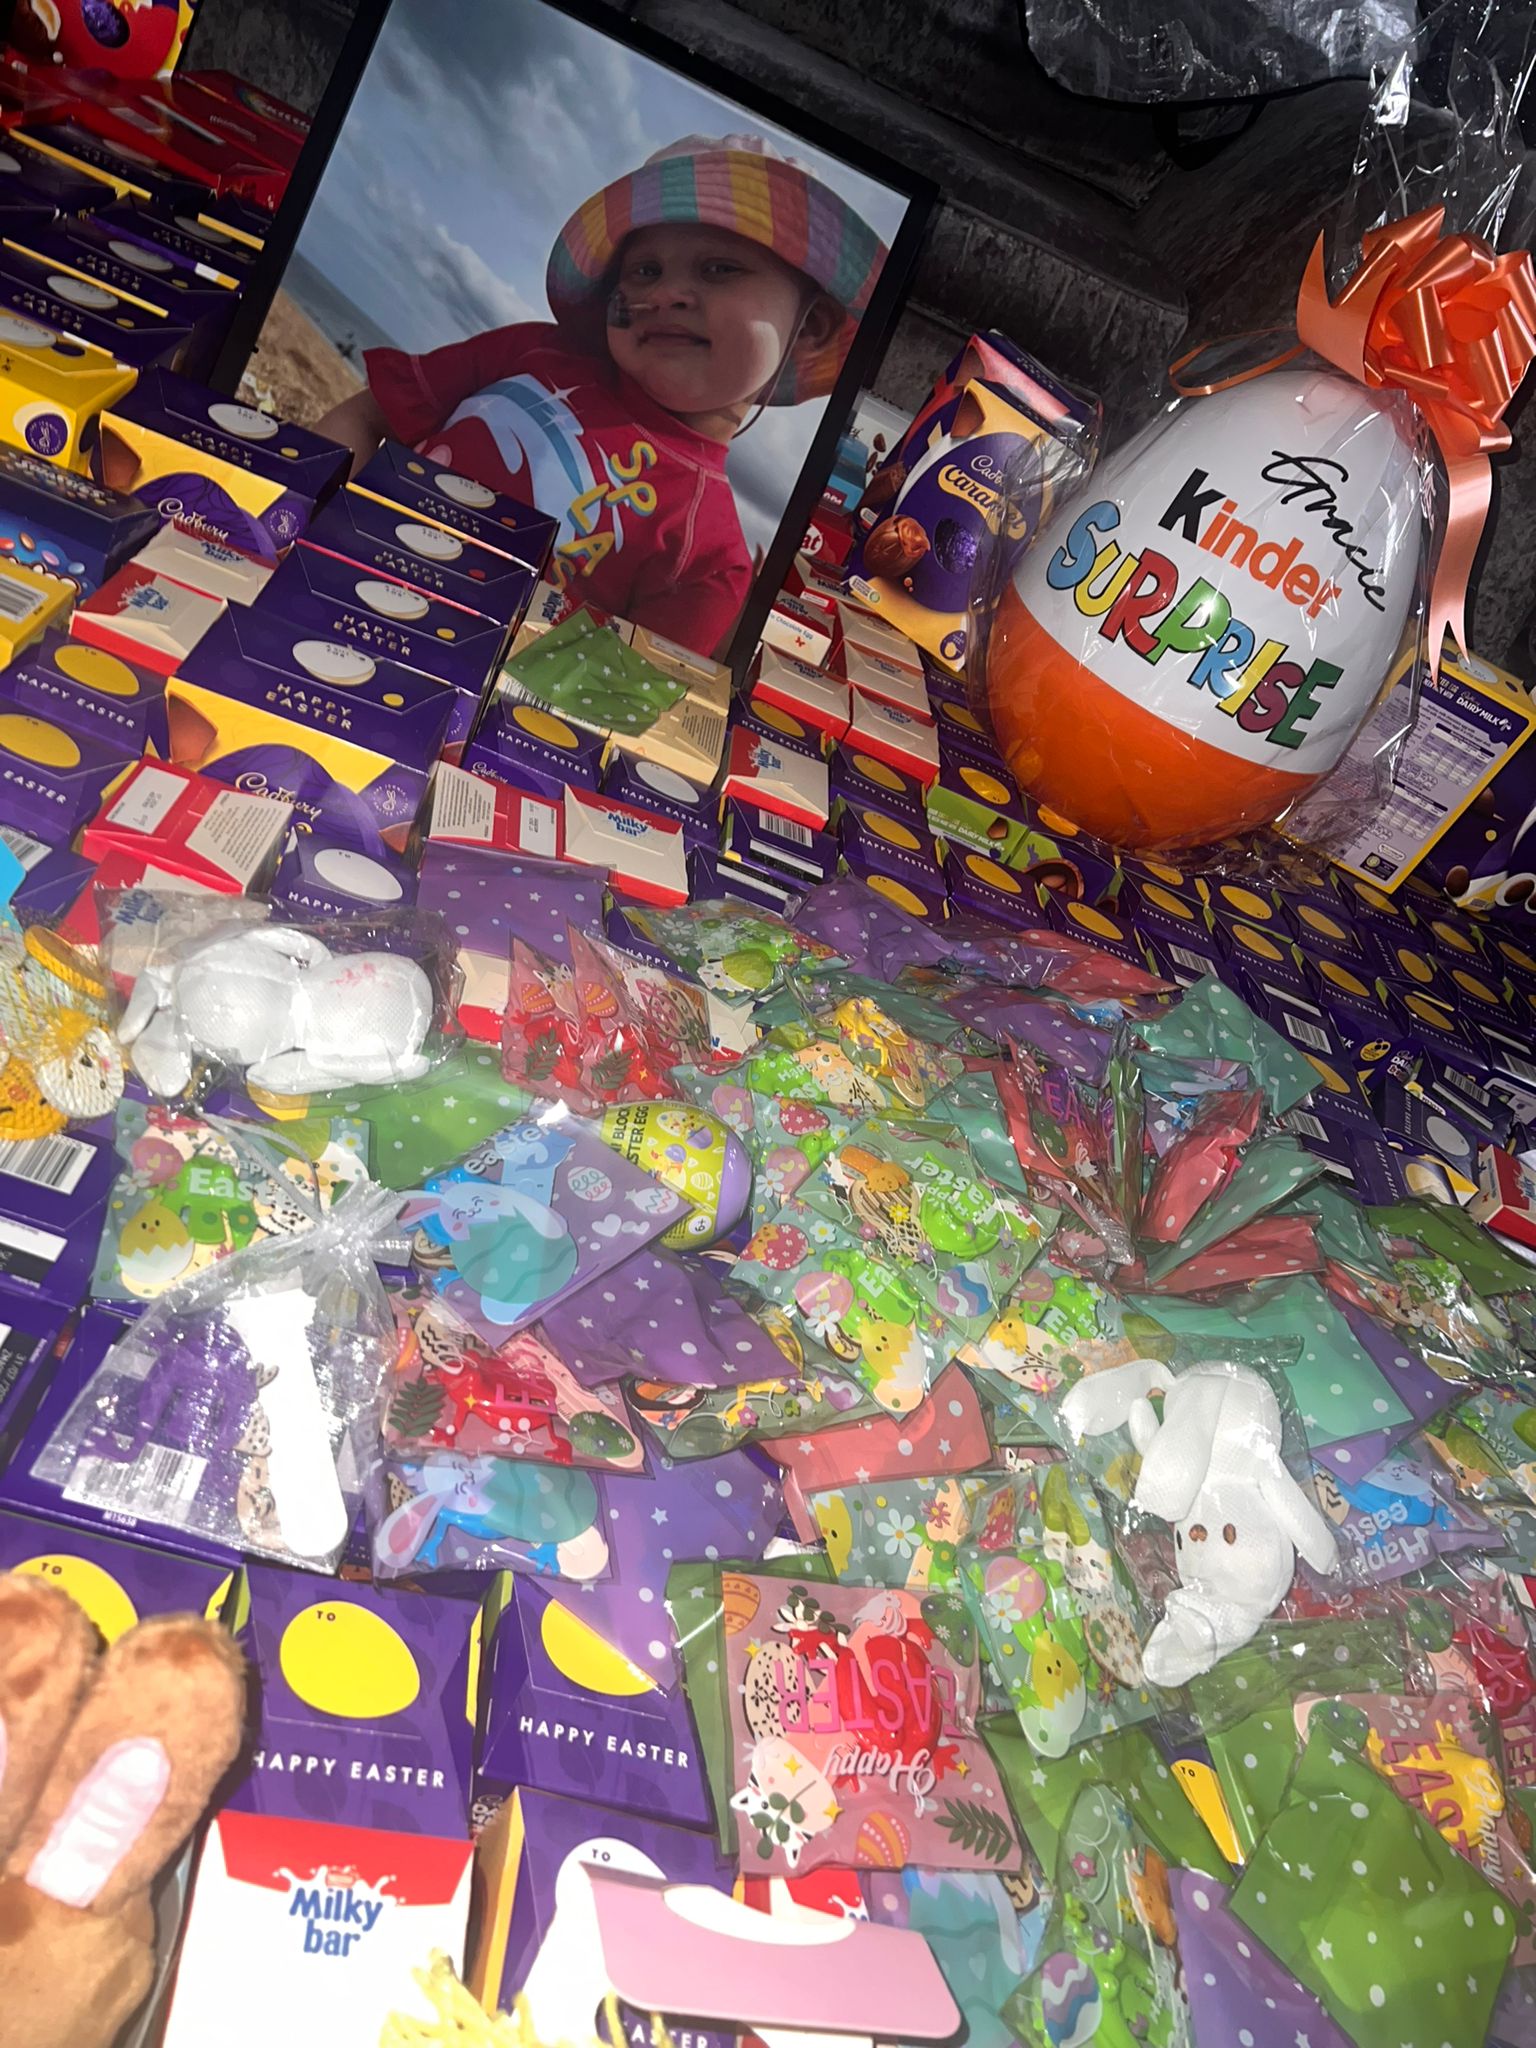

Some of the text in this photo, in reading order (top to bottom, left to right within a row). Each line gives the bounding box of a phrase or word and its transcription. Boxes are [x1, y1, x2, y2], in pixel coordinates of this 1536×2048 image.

[158, 497, 229, 541] Cadbury
[1261, 450, 1386, 612] Gracie
[1159, 468, 1342, 619] Kinder
[333, 621, 411, 656] EASTER
[343, 614, 409, 643] HAPPY
[1046, 500, 1345, 750] SURPRISE
[17, 672, 136, 729] HAPPY EASTER
[266, 691, 352, 730] EASTER
[277, 683, 352, 716] HAPPY
[1456, 697, 1501, 726] DAIRY MILK
[497, 731, 589, 776] HAPPY EASTER
[741, 719, 816, 759] HAPPY EASTER
[3, 770, 67, 805] EASTER
[236, 772, 323, 822] Cadbury
[844, 775, 917, 814] HAPPY EASTER
[608, 812, 649, 833] Milky
[621, 787, 709, 831] HAPPY EASTER
[616, 823, 641, 838] bar
[859, 837, 936, 874] HAPPY EASTER
[289, 891, 343, 914] HAPPY
[964, 882, 1038, 917] HAPPY EASTER
[1142, 908, 1209, 942] HAPPY EASTER
[626, 947, 670, 968] HAPPY
[1067, 929, 1140, 964] HAPPY EASTER
[1235, 951, 1300, 983] HAPPY EASTER
[614, 1105, 630, 1140] BLOCK
[634, 1104, 650, 1126] EGG
[1334, 1101, 1370, 1121] EASTER
[1343, 1501, 1409, 1545] east
[41, 1563, 62, 1575] TO
[316, 1610, 336, 1622] TO
[775, 1658, 965, 1739] EASTER
[519, 1716, 690, 1769] HAPPY EASTER
[252, 1750, 445, 1789] HAPPY EASTER
[820, 1744, 937, 1796] Happy
[592, 1849, 611, 1861] TO
[289, 1886, 384, 1932] Milky
[303, 1919, 361, 1957] bar
